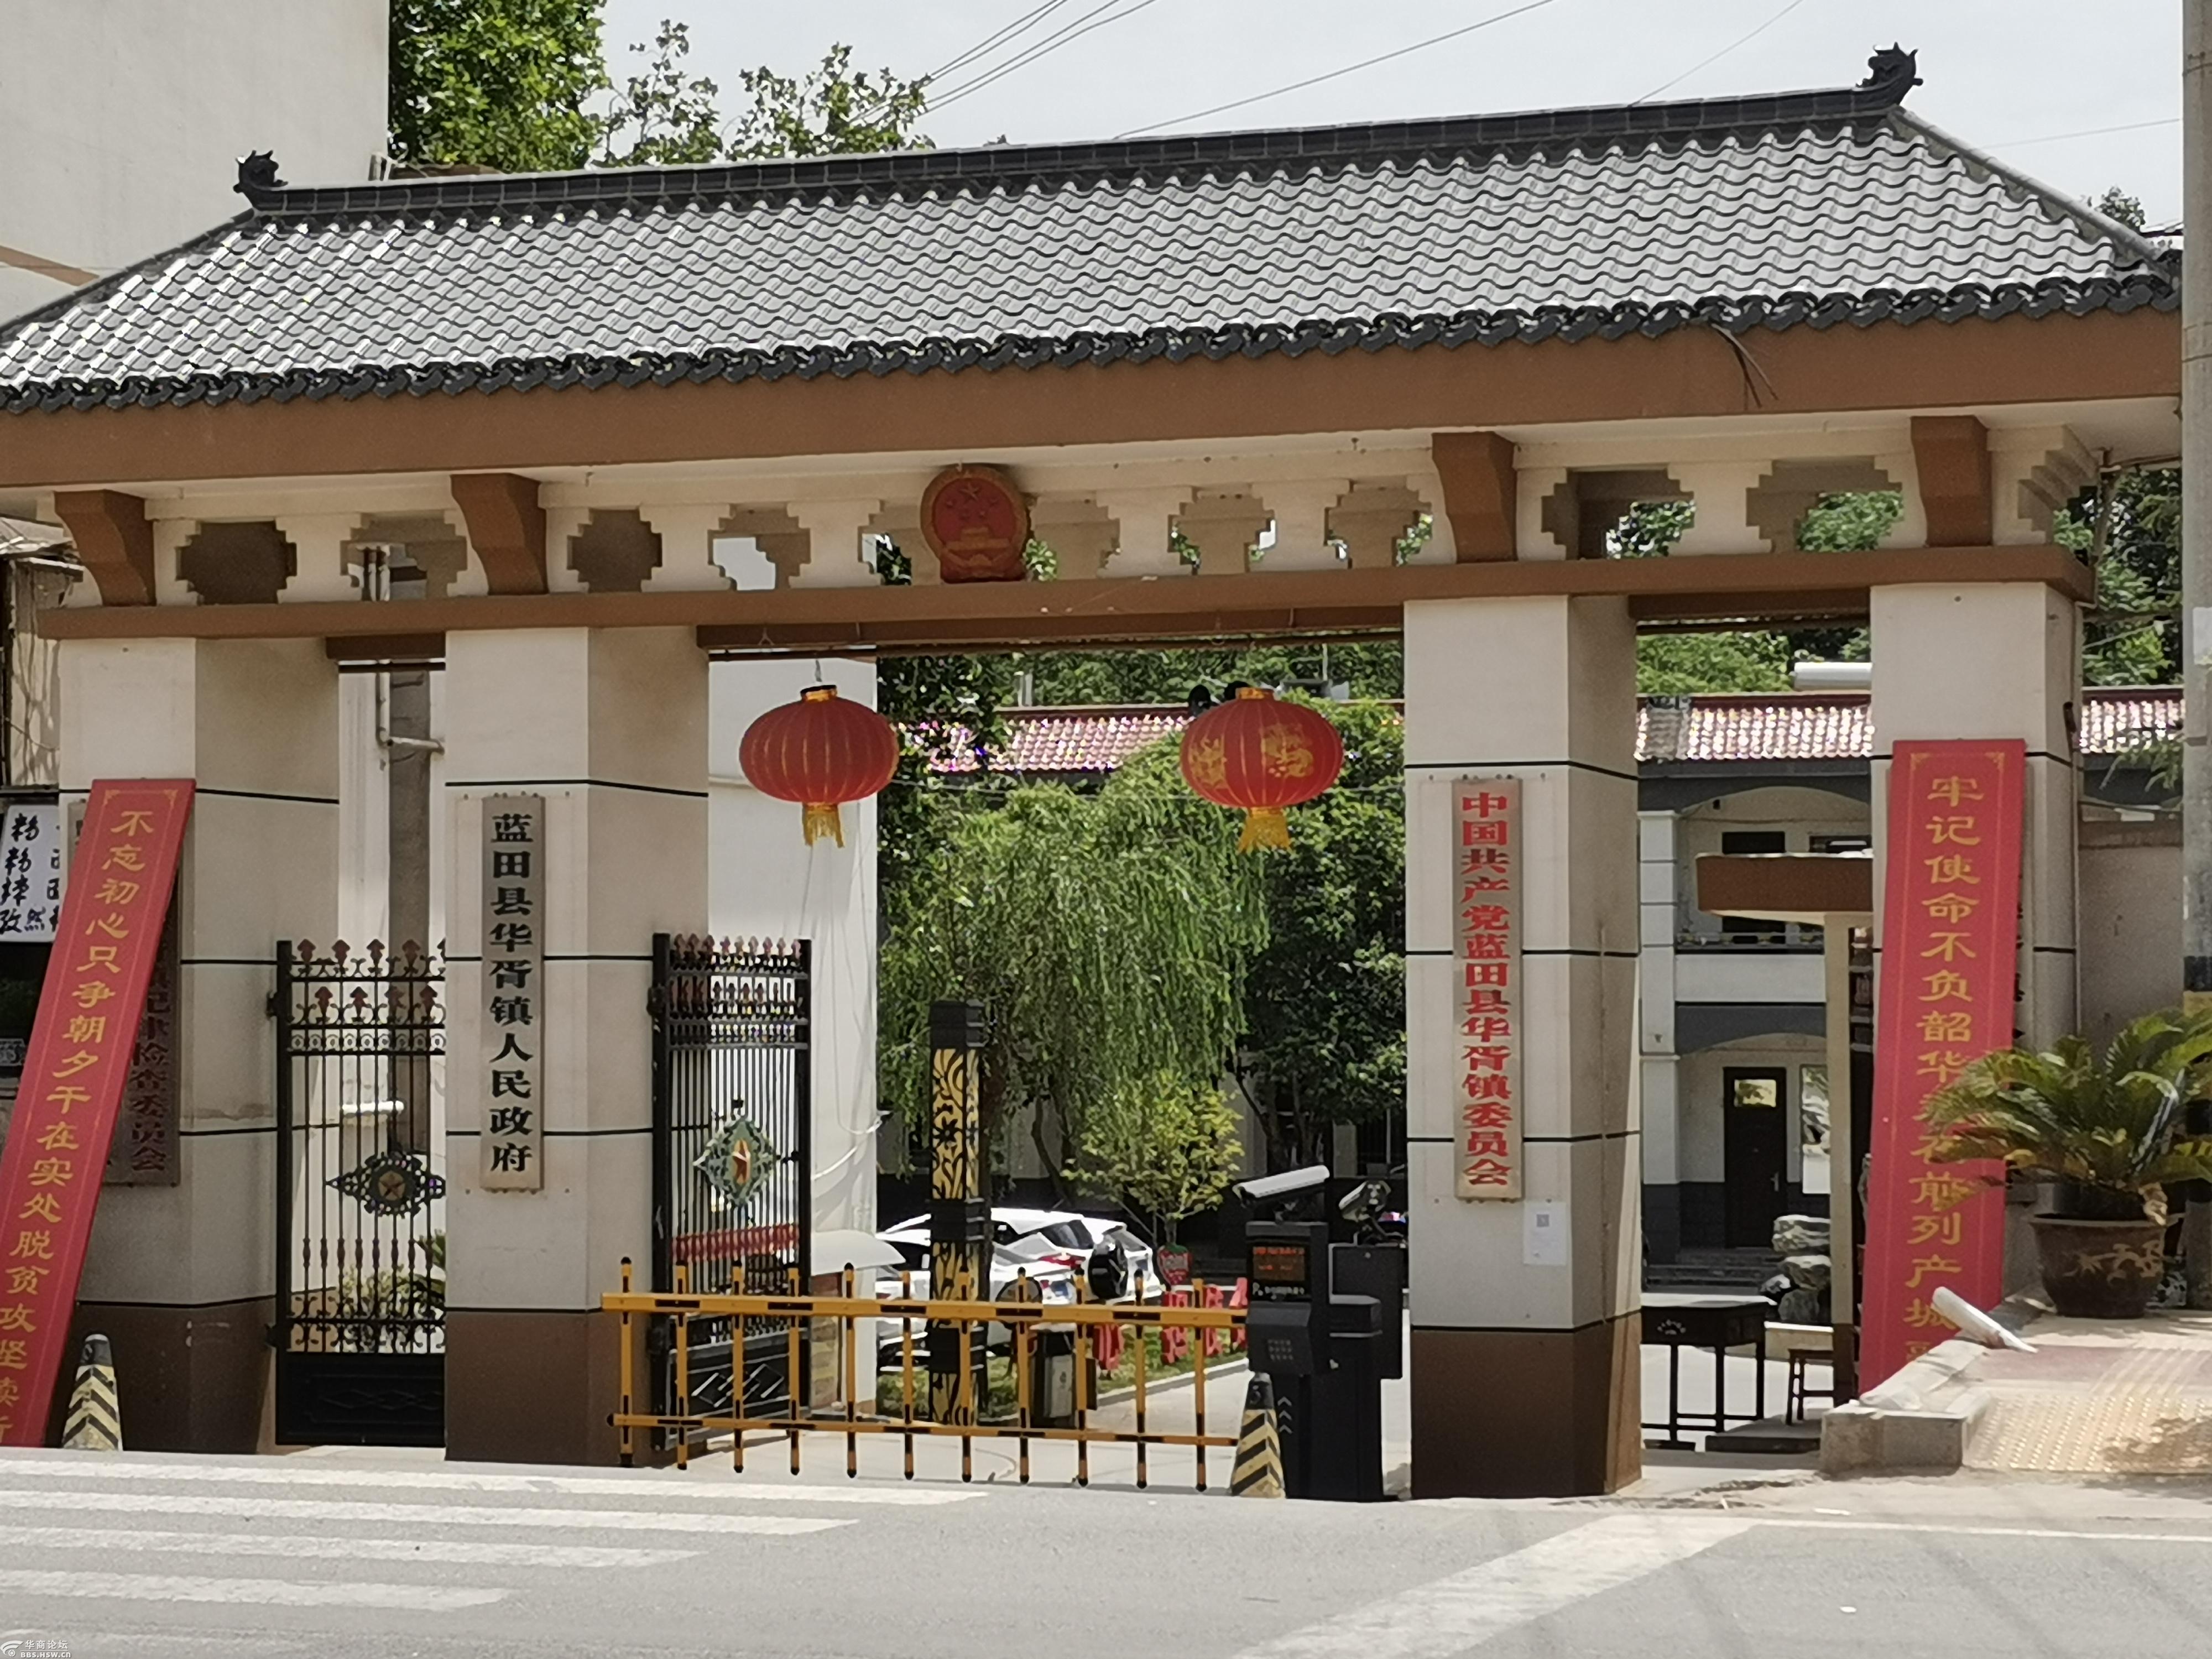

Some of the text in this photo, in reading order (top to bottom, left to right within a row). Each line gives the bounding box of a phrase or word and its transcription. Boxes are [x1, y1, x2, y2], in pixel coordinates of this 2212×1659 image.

[489, 813, 534, 1172] 蓝田县华胥镇人民政府
[1460, 792, 1512, 1186] 中国共产党蓝田县华胥镇委员会
[1902, 775, 1985, 1360] 牢记使命不负韶华在前列产城
